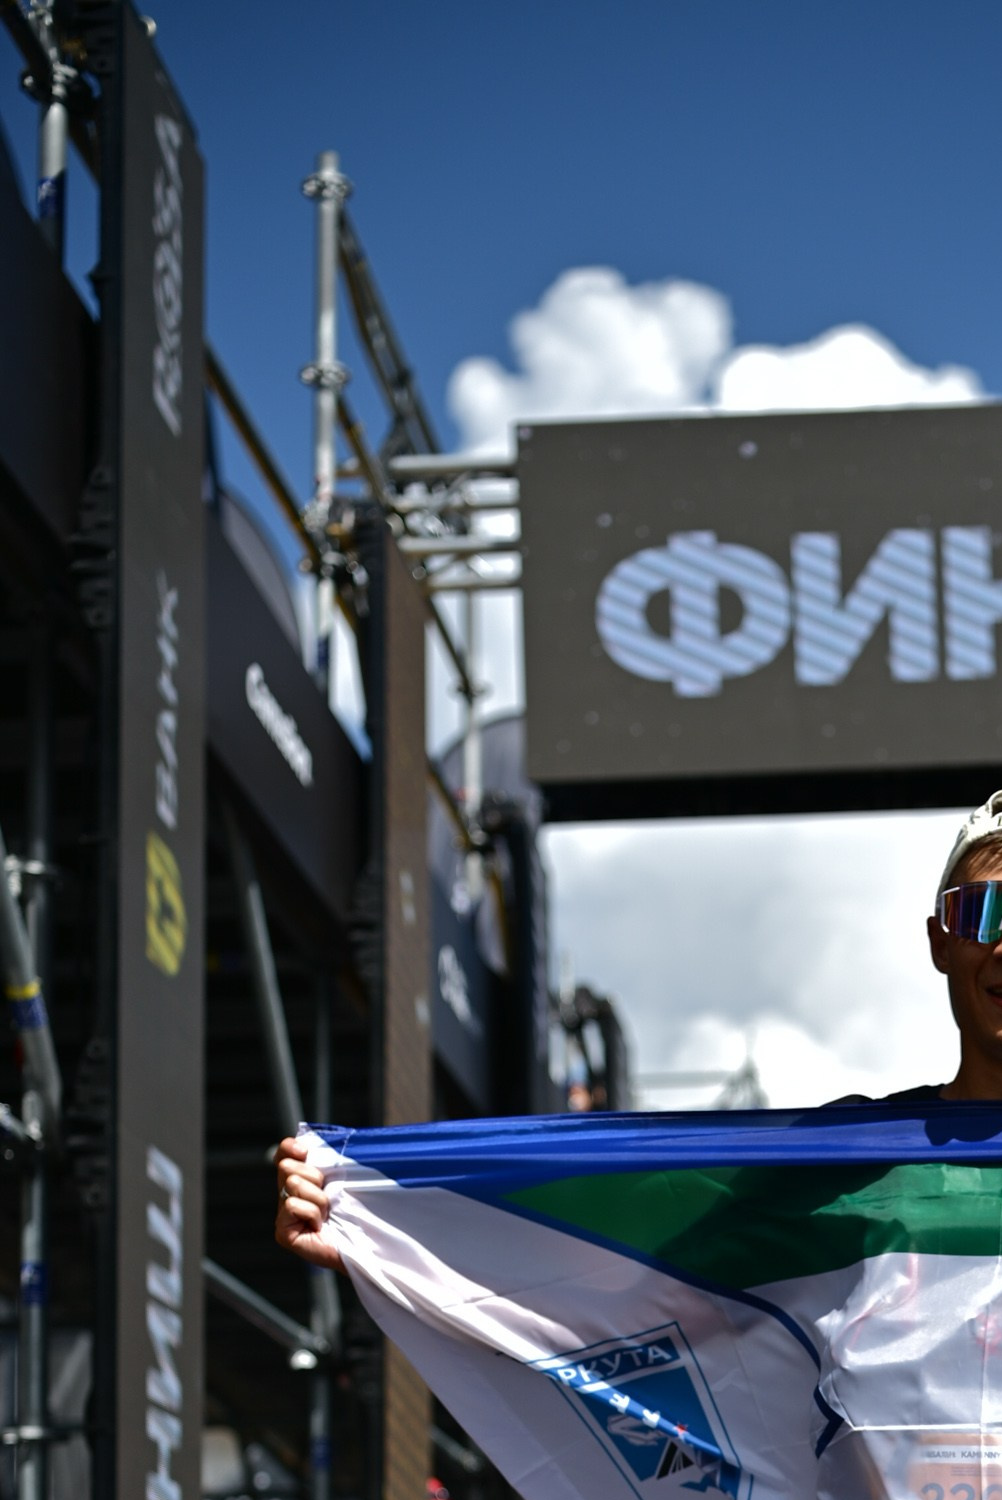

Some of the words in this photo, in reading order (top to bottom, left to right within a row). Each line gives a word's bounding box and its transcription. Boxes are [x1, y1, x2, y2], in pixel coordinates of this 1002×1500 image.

[152, 113, 183, 437] ROSA
[156, 569, 179, 830] БАНК
[556, 1344, 672, 1386] РКУТА
